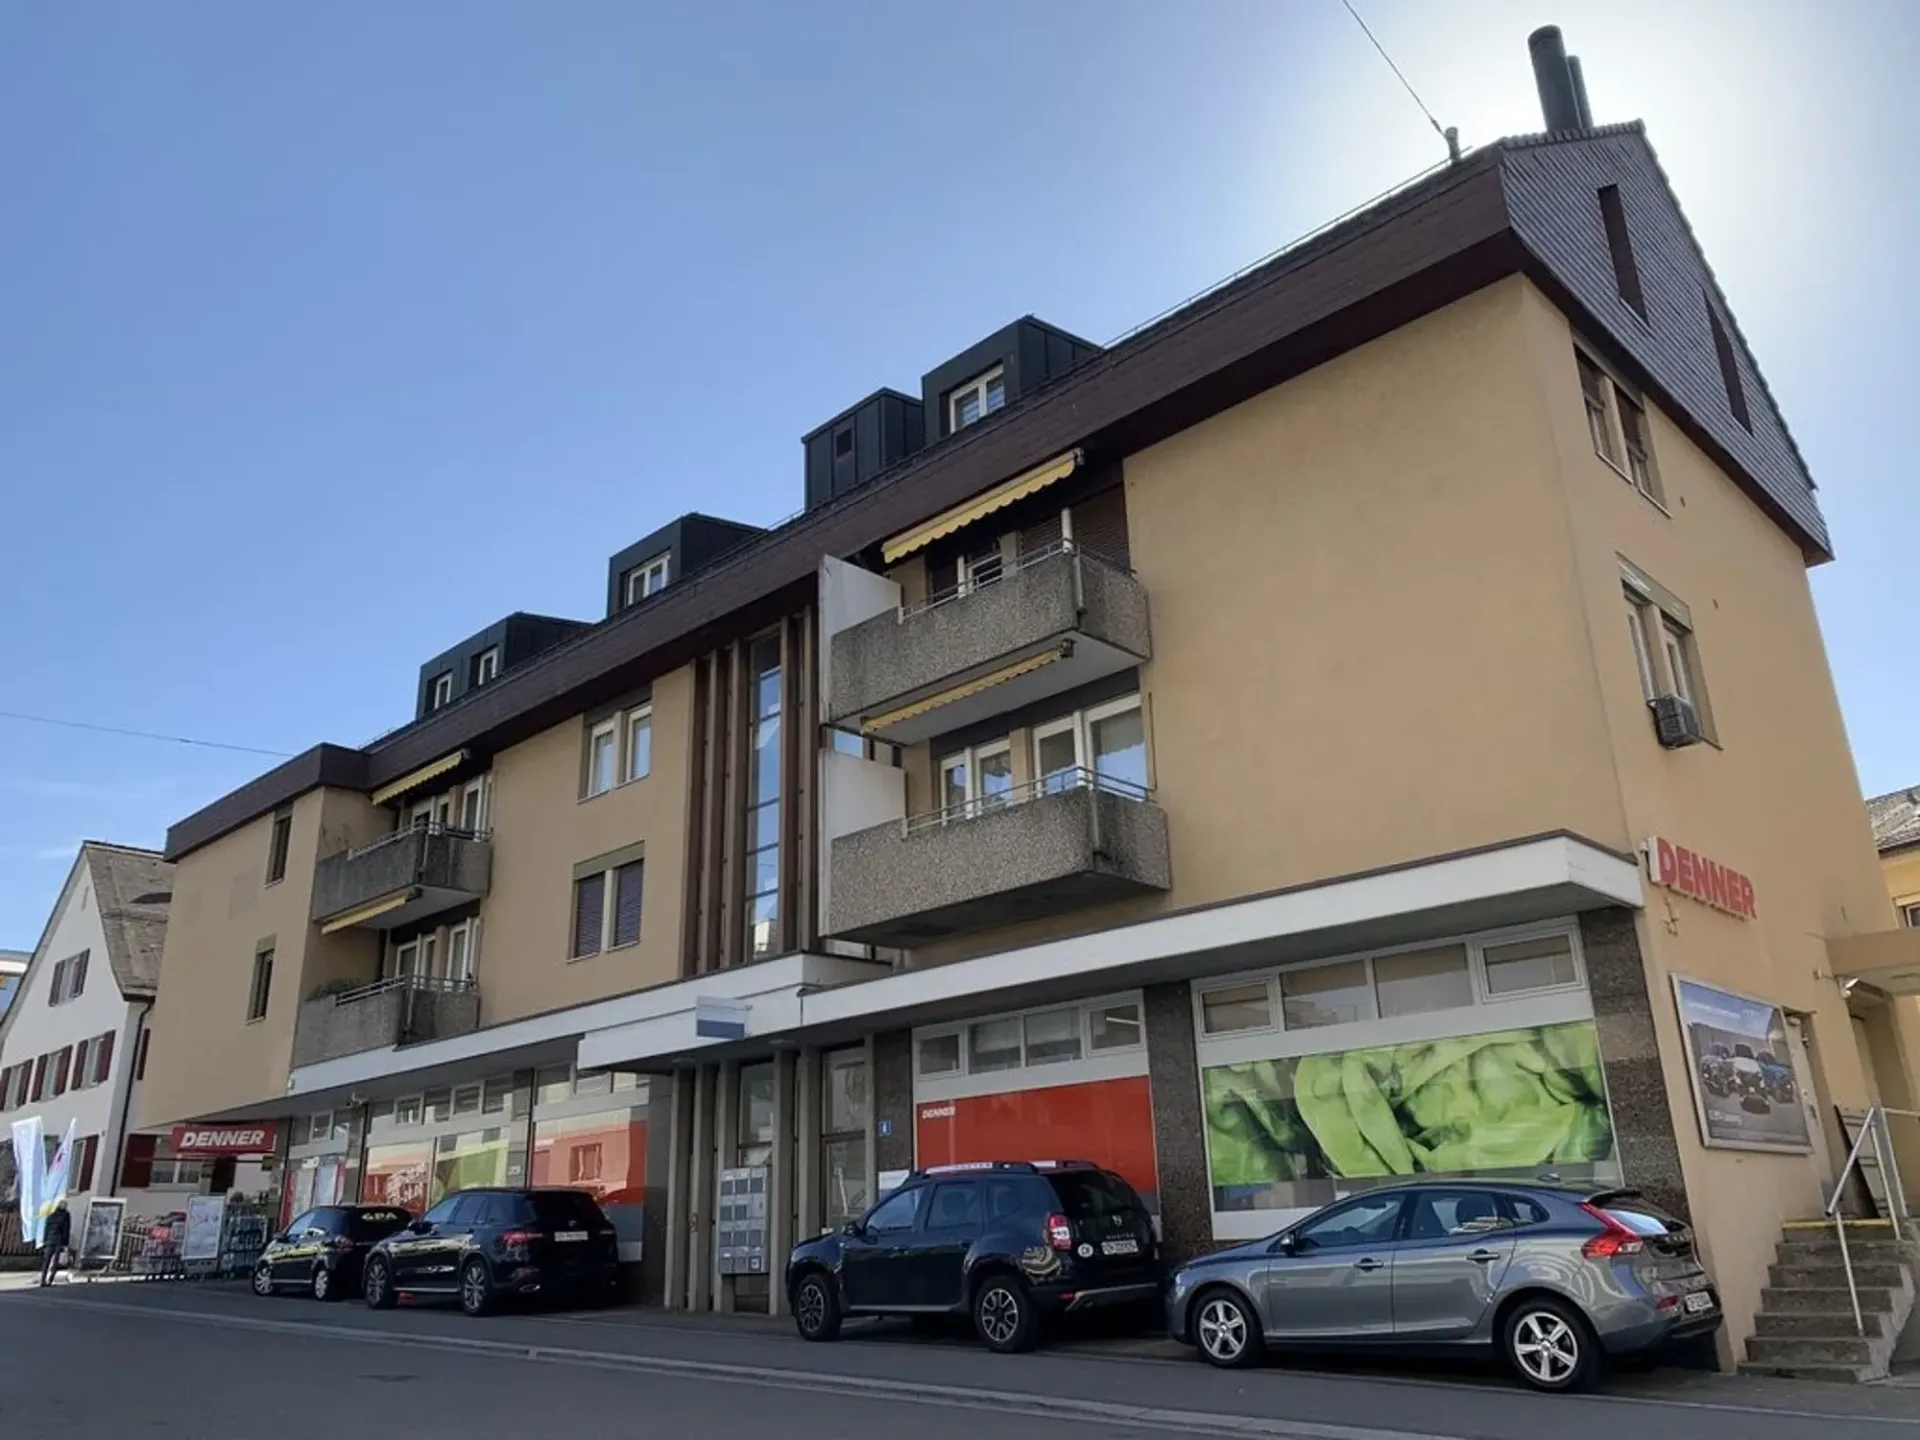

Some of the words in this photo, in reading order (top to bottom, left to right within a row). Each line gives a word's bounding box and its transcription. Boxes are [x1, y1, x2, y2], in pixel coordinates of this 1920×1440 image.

[1655, 836, 1757, 920] DENNER
[922, 1106, 956, 1118] DENNER
[179, 1129, 265, 1148] DENNER
